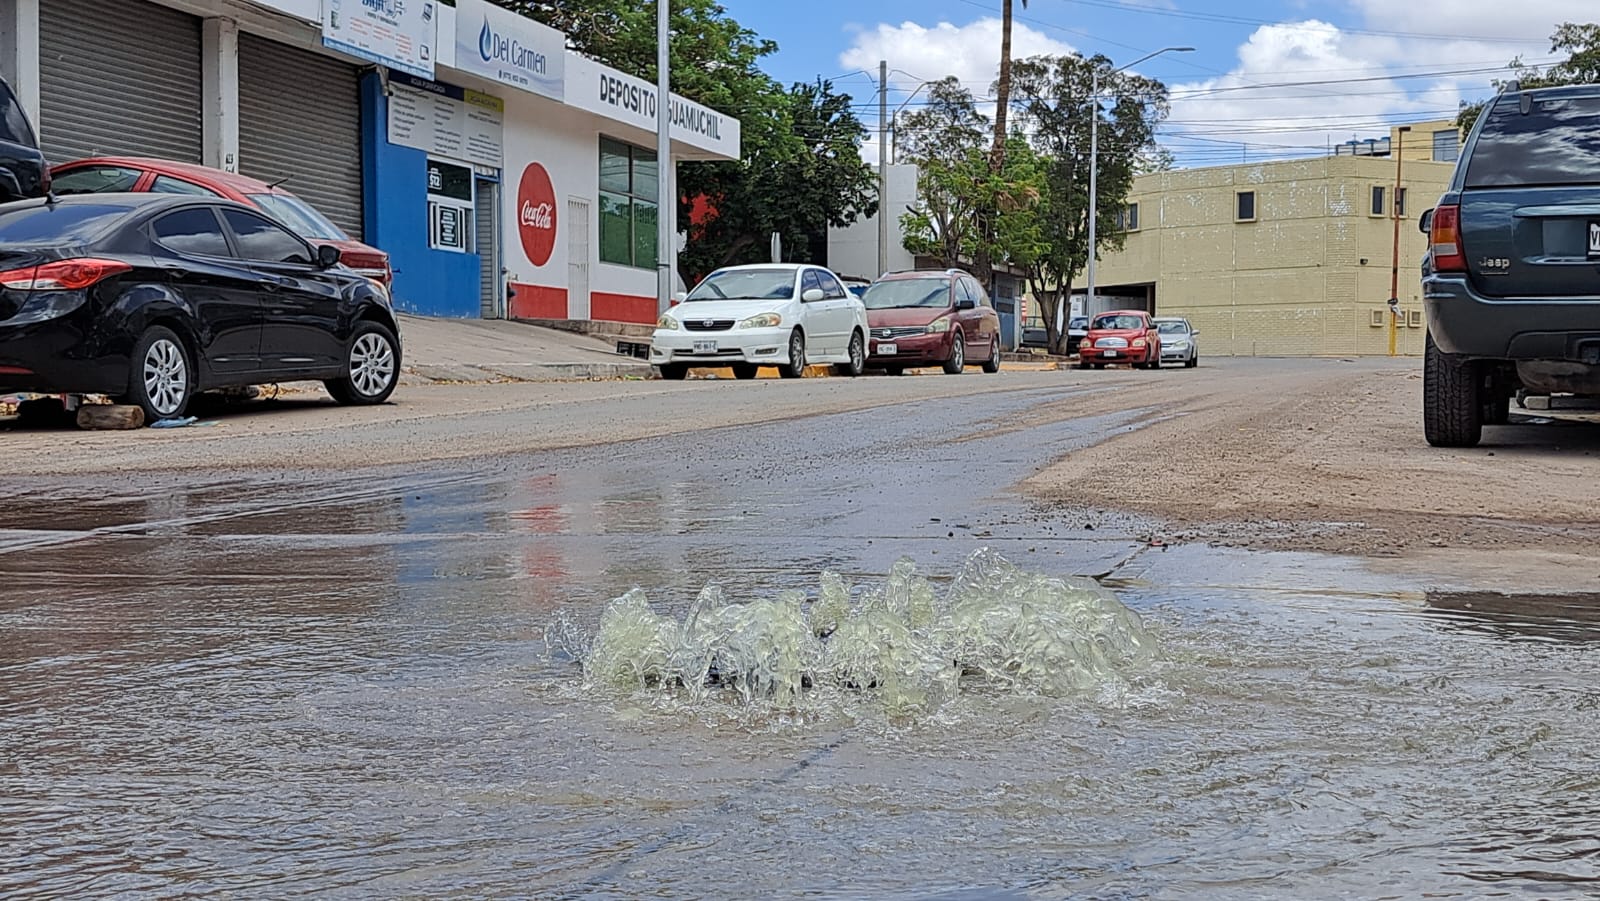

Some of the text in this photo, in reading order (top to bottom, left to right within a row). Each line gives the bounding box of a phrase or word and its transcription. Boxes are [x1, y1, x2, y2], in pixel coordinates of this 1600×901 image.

[493, 32, 546, 76] Del Carmen
[600, 73, 656, 118] DEPOSITO
[1479, 256, 1511, 269] Jeep
